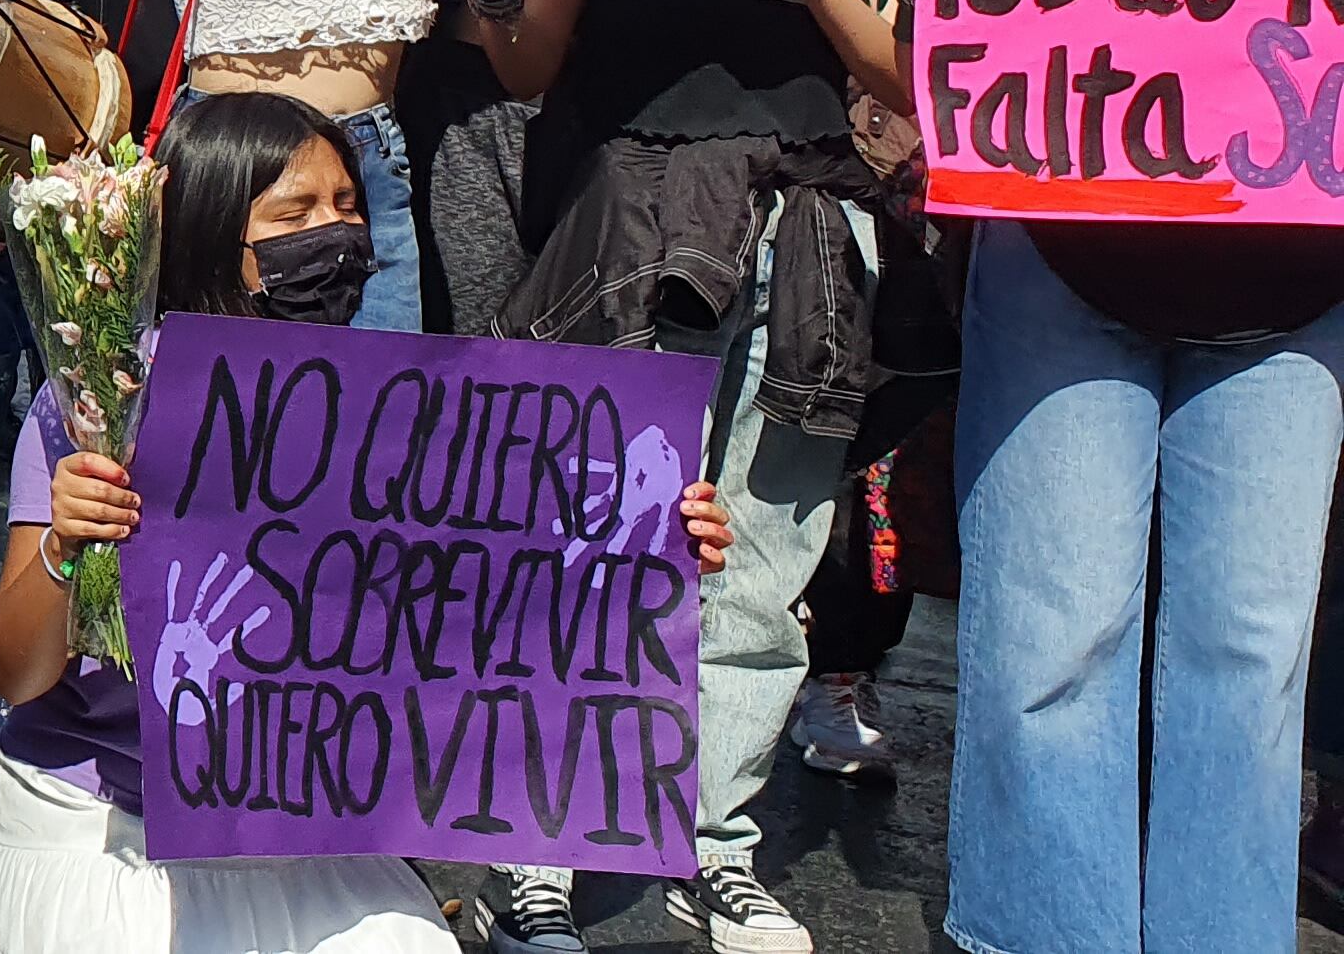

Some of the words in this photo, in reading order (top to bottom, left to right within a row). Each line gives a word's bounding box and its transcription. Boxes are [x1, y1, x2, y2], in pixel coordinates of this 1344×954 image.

[928, 43, 1223, 180] Falta
[175, 354, 343, 519] NO
[350, 368, 624, 542] QUIERO
[232, 519, 686, 688] SOBREVIVIR
[168, 680, 392, 818] QUIERO
[405, 685, 696, 867] VIVIR
